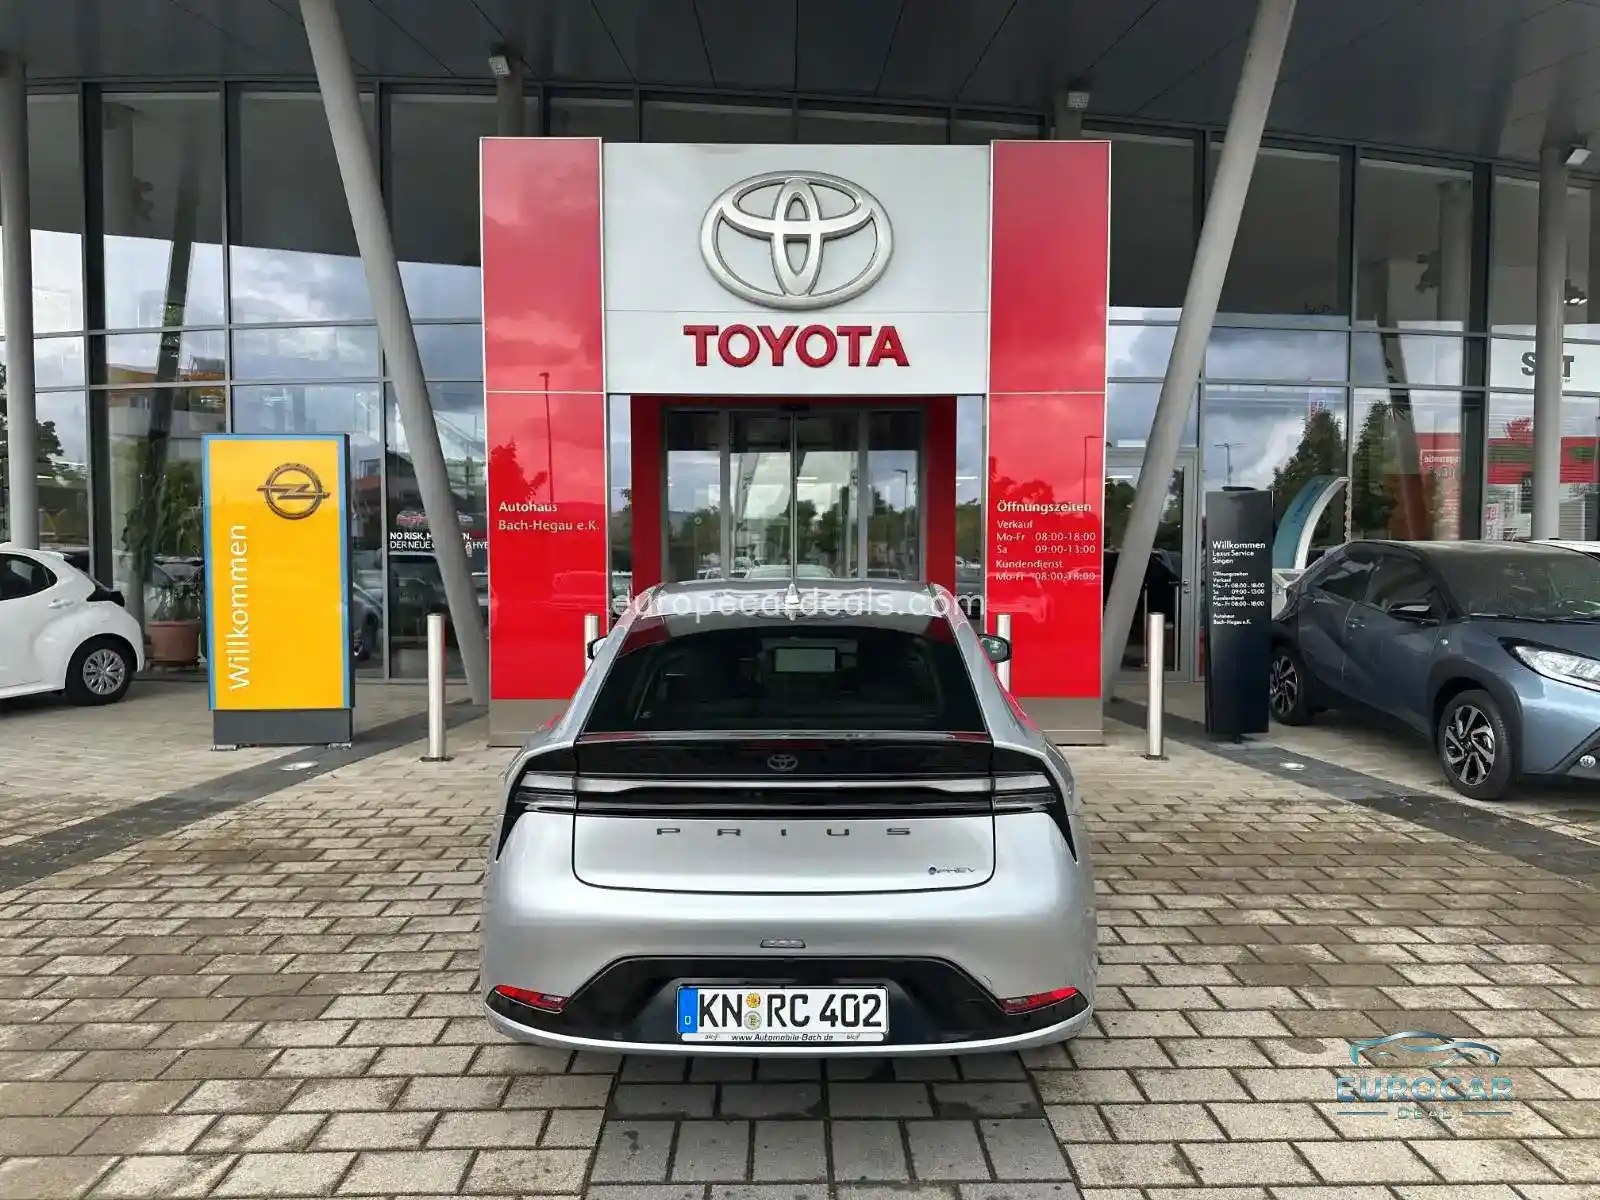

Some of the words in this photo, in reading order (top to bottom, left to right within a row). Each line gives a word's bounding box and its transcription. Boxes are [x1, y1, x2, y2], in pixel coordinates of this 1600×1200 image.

[683, 324, 910, 368] TOYOTA
[1521, 351, 1574, 378] ST
[498, 502, 558, 512] Autohaus
[997, 500, 1093, 515] Öffnungszeiten
[498, 520, 573, 533] Bach-Hegau
[576, 521, 600, 531] e.K.
[997, 520, 1033, 529] Verkauf
[389, 532, 403, 540] NO
[404, 532, 426, 542] RISK,
[996, 532, 1025, 541] Mo-Fr
[389, 541, 407, 549] DER
[408, 541, 431, 549] NEUE
[997, 545, 1008, 554] Sa
[1212, 540, 1266, 549] Willkommen
[996, 560, 1063, 569] Kundendienst
[995, 572, 1025, 581] Mo-Fr
[224, 525, 249, 691] Willkommen
[656, 827, 912, 837] PRIUS
[699, 993, 743, 1028] KN
[767, 993, 811, 1028] RC
[819, 993, 882, 1028] 402
[684, 1015, 692, 1026] D
